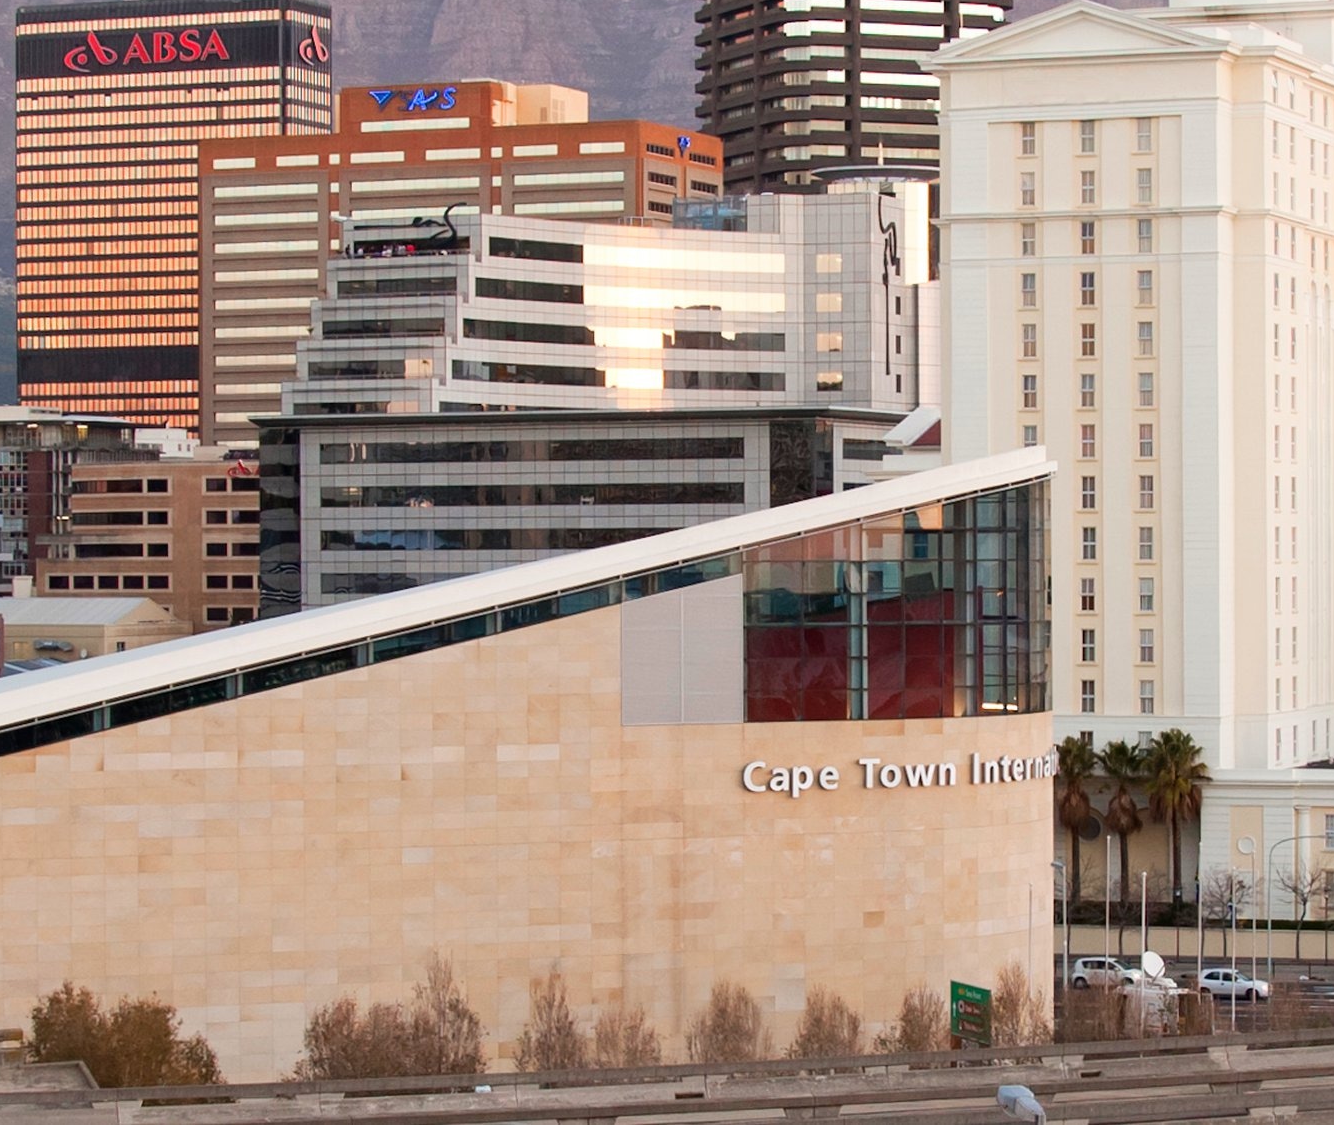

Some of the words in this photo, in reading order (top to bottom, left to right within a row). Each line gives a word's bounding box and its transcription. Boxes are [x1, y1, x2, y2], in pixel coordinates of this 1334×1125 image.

[123, 28, 230, 65] ABSA
[742, 760, 840, 799] Cape
[858, 757, 957, 789] Town
